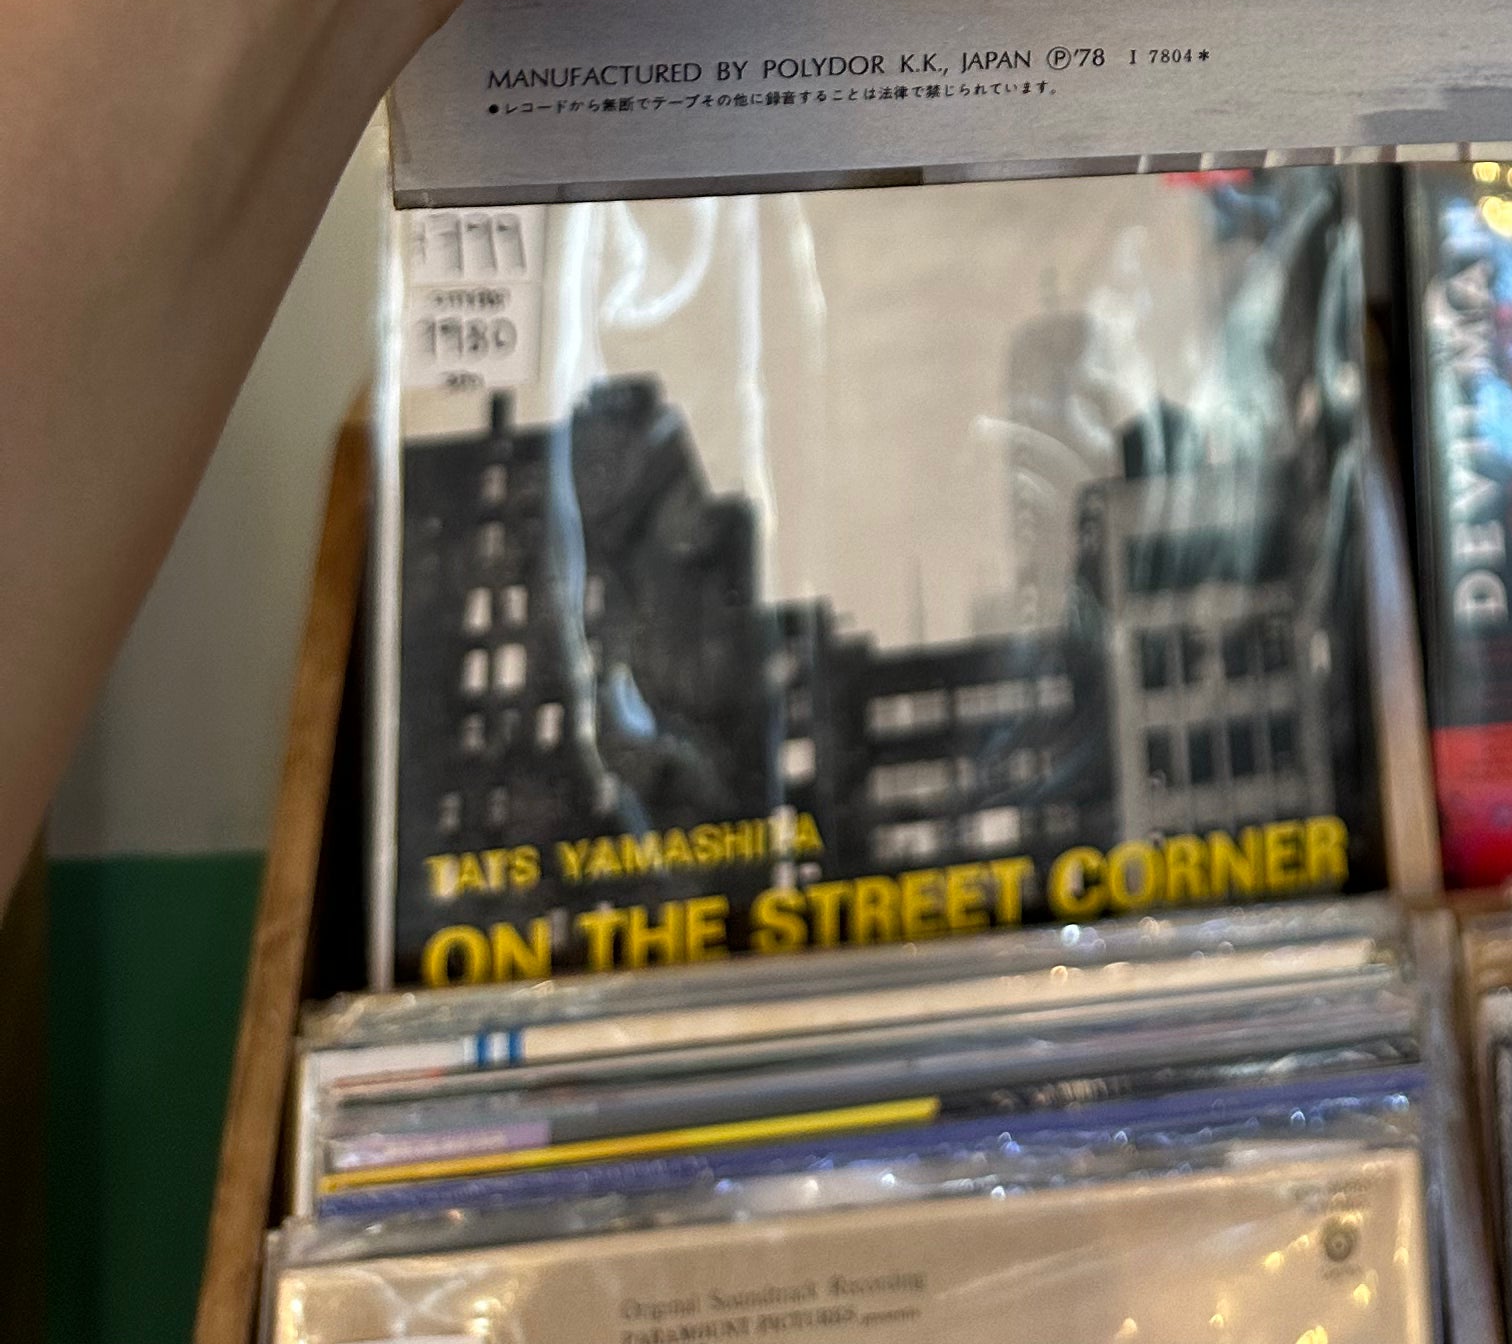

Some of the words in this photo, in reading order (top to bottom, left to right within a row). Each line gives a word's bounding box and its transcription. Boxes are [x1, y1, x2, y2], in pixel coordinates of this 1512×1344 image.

[487, 61, 703, 90] MANUFACTURED
[717, 59, 750, 83] BY
[762, 54, 886, 80] POLYDOR
[960, 48, 1032, 74] JAPAN
[423, 845, 541, 901] TATS
[421, 915, 554, 989] ON
[574, 893, 730, 972] THE
[749, 855, 1035, 955] STREET
[1047, 814, 1350, 920] CORNER
